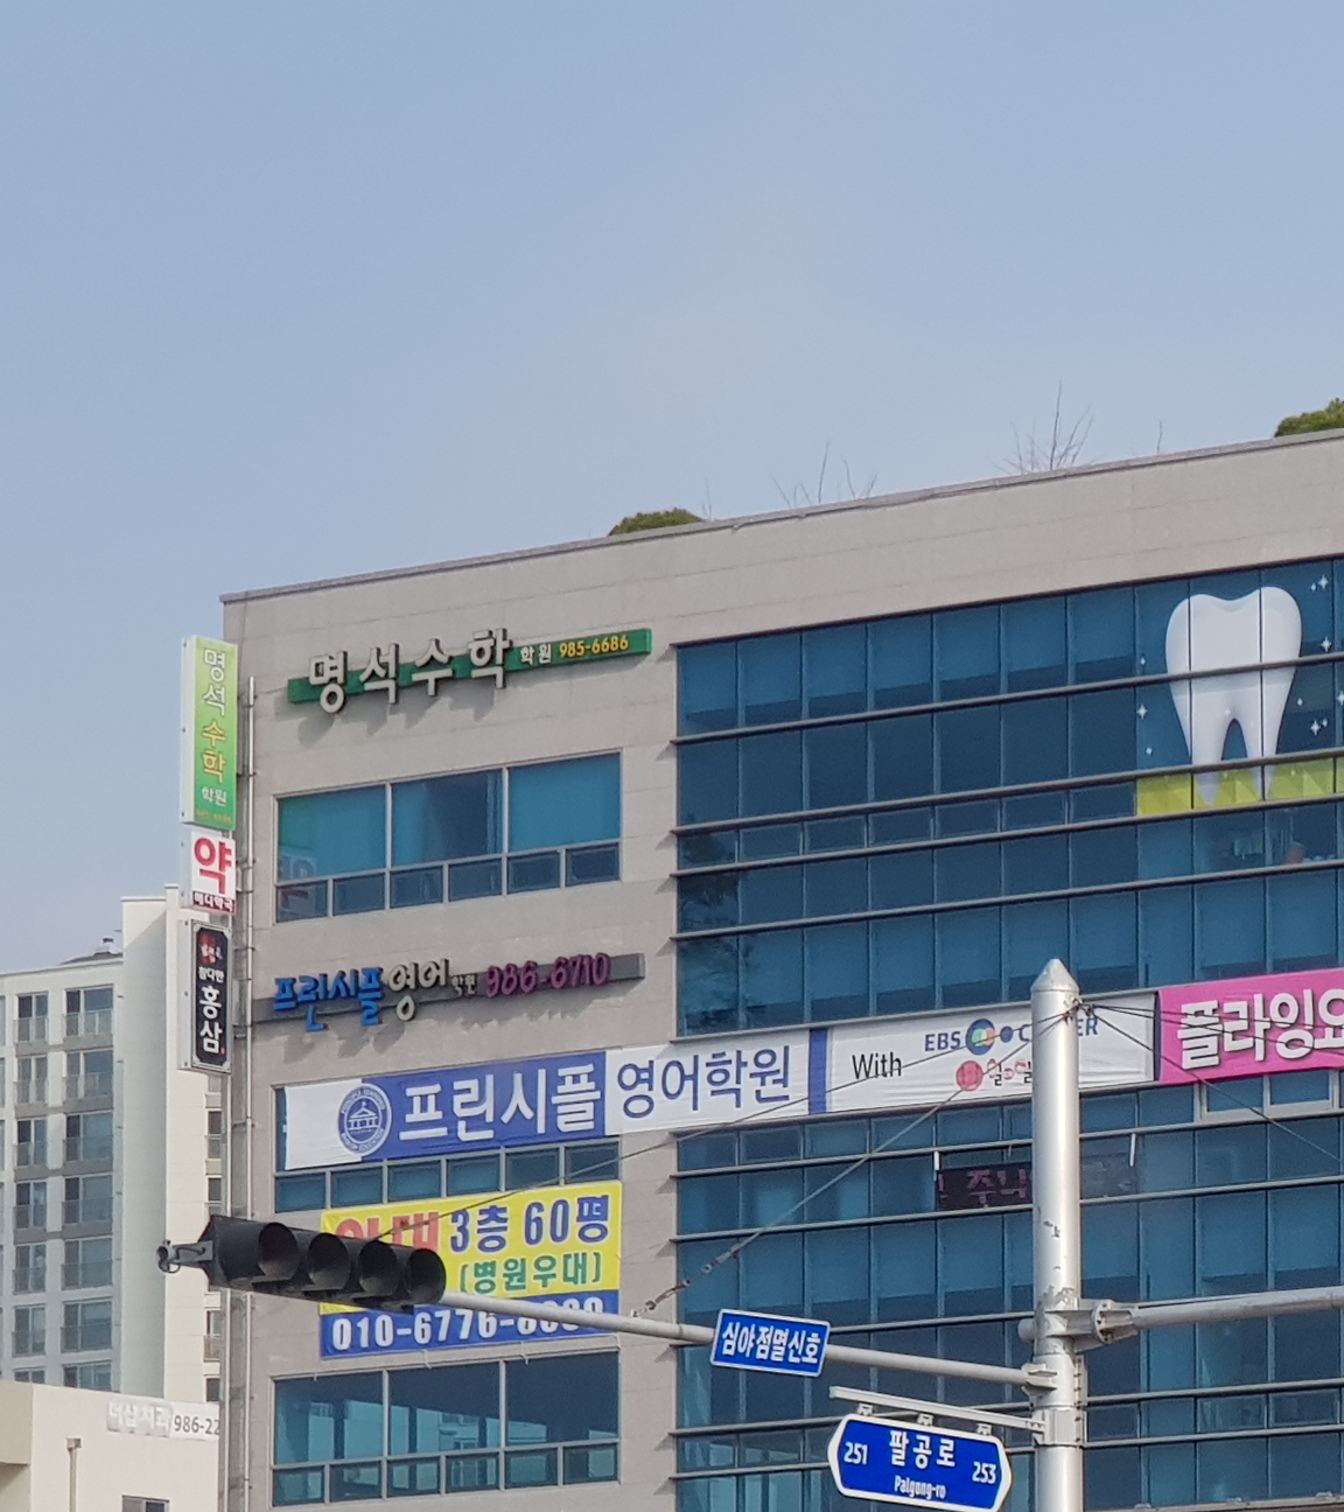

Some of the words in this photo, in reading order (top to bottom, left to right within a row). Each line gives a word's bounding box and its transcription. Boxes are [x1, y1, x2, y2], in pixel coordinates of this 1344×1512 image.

[308, 628, 512, 713] 명석수학
[521, 643, 553, 665] 학원
[559, 634, 630, 657] 985-6686
[194, 838, 232, 894] 약
[387, 959, 450, 1020] 영어
[484, 952, 610, 997] 986-6710
[199, 985, 223, 1054] 홍삼
[925, 1031, 962, 1052] EBS
[399, 1061, 602, 1143] 프린시플
[616, 1044, 793, 1120] 영어학원
[852, 1051, 902, 1081] With
[450, 1204, 509, 1254] 3층
[523, 1194, 610, 1248] 60평
[843, 1441, 868, 1466] 251
[889, 1429, 956, 1470] 팔공로
[972, 1460, 998, 1485] 253
